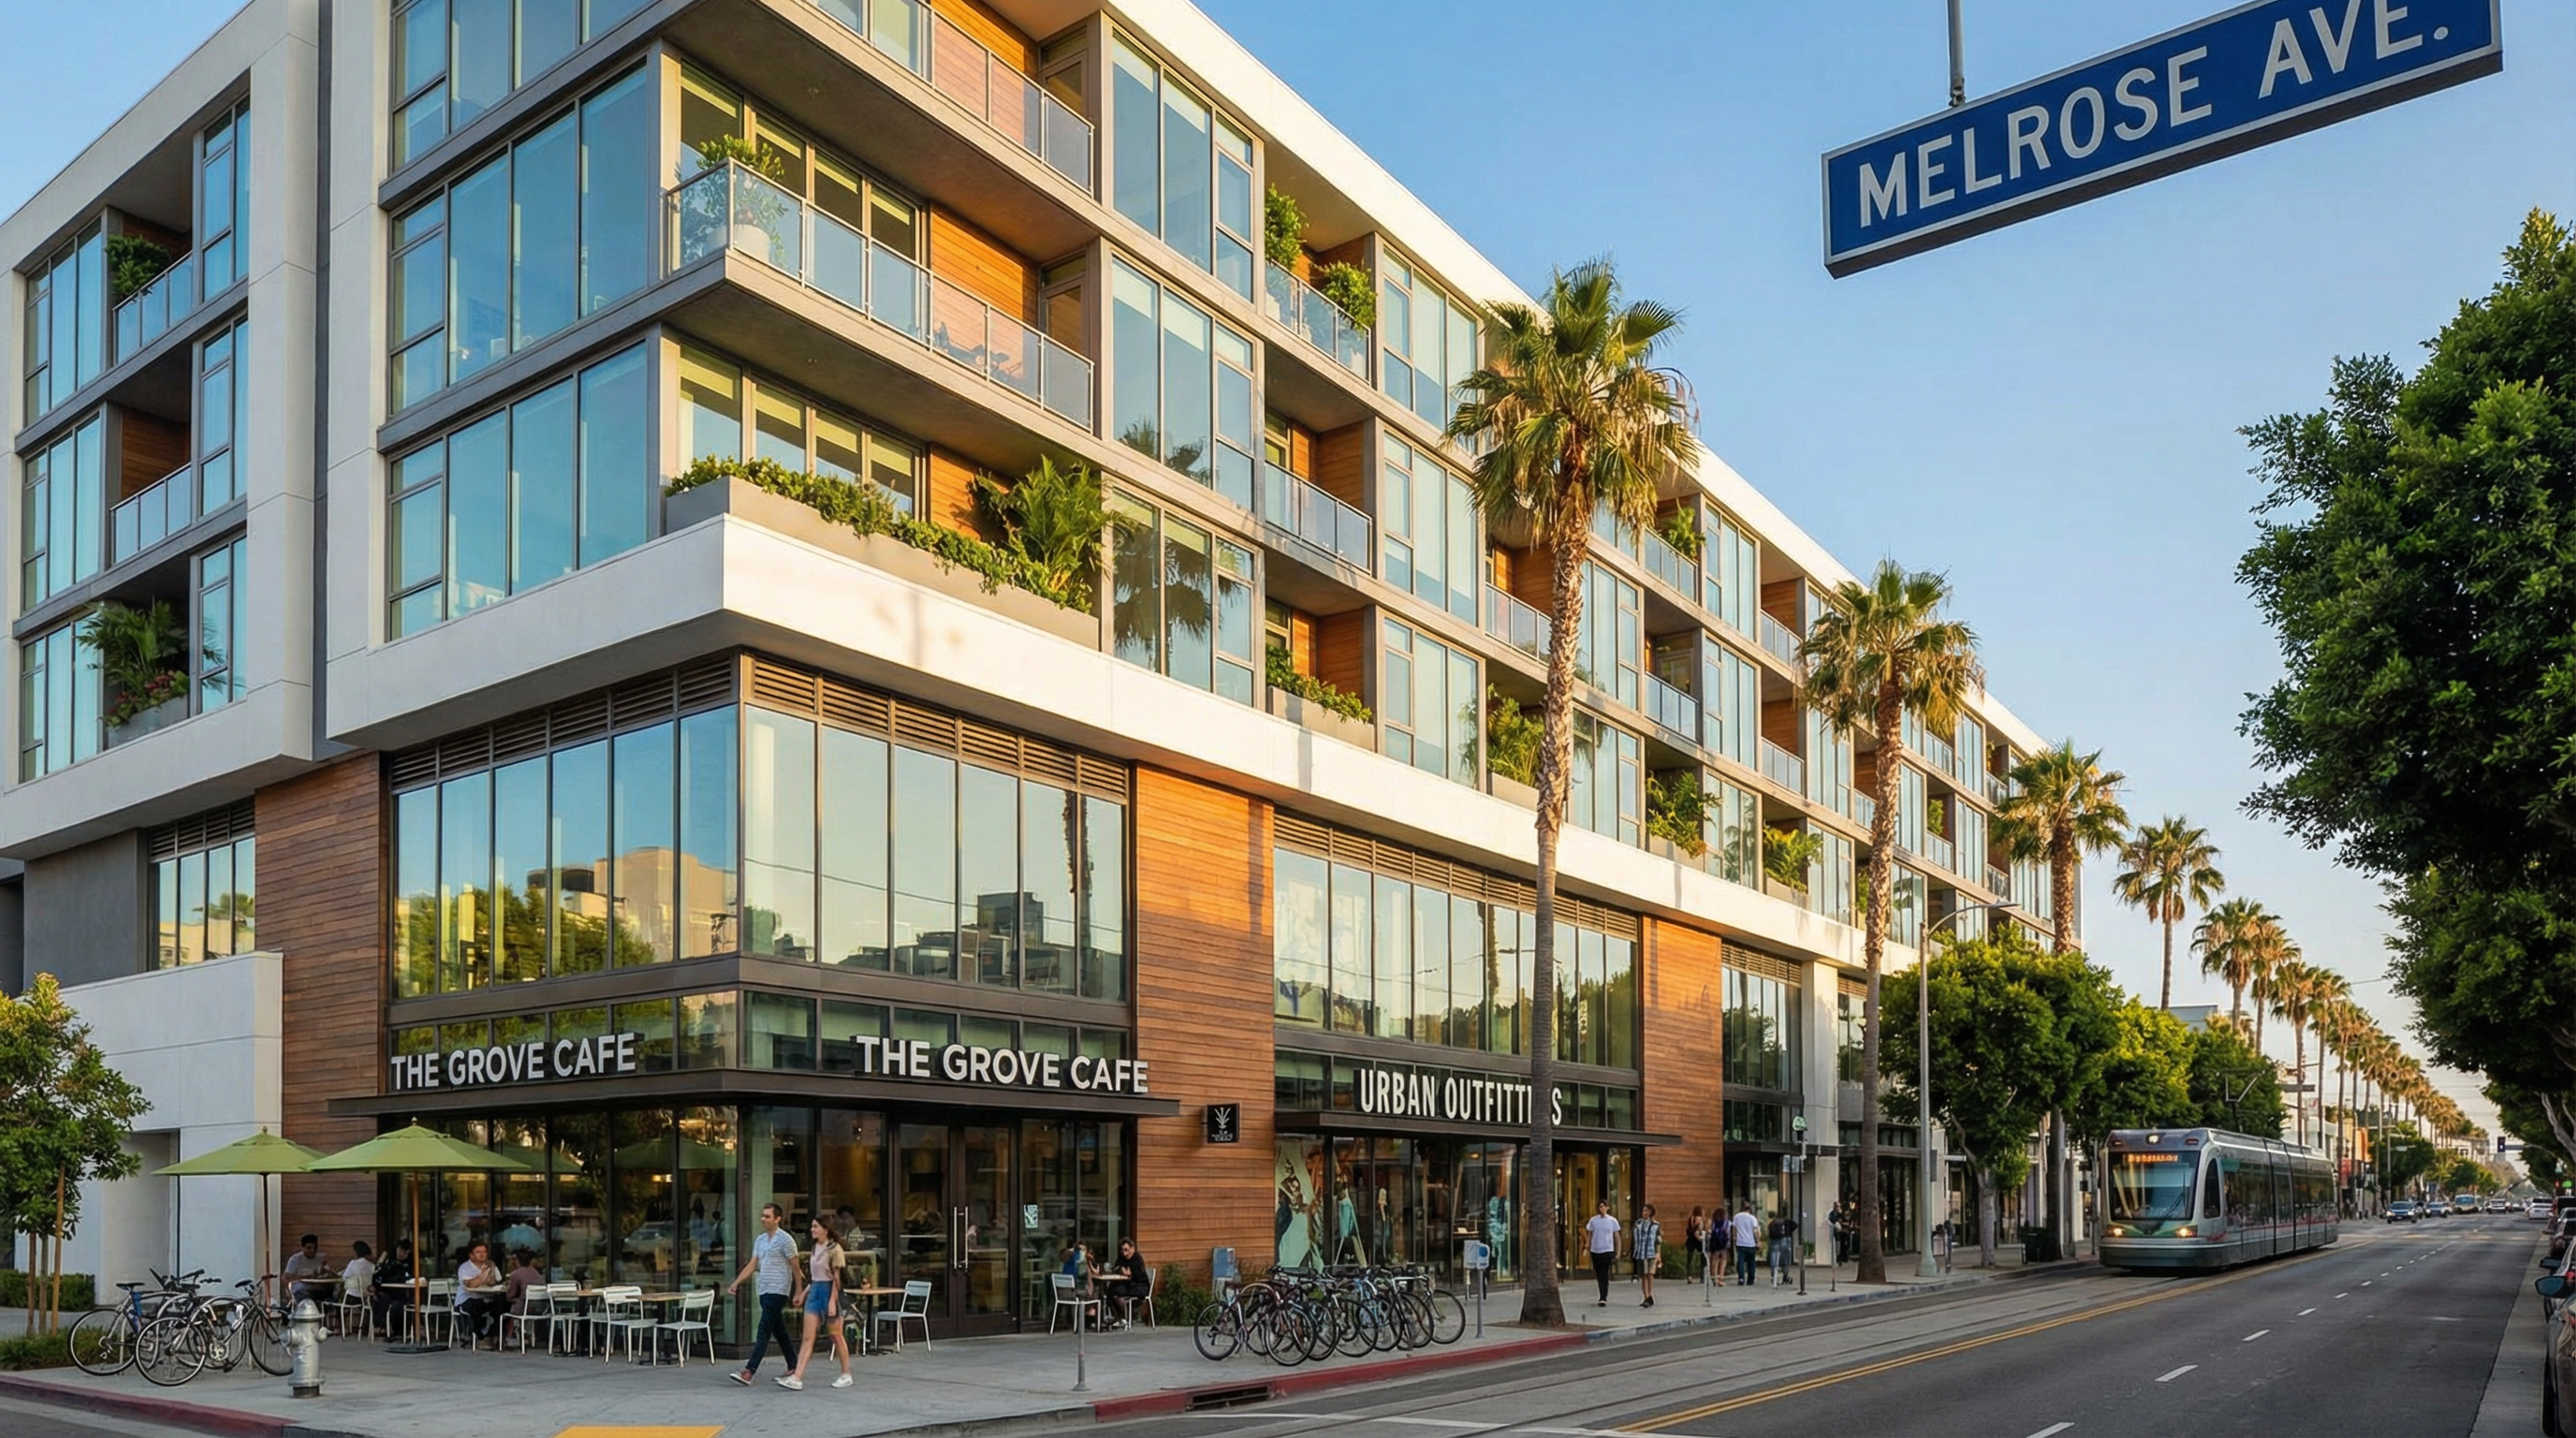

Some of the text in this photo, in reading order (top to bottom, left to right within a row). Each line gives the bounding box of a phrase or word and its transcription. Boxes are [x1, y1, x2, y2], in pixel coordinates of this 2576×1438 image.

[1860, 0, 2450, 228] MELROSE AVE.
[391, 1032, 637, 1090] THE GROVE CAFE
[856, 1034, 1149, 1093] THE GROVE CAFE
[1360, 1068, 1562, 1125] URBAN OUTFITTS
